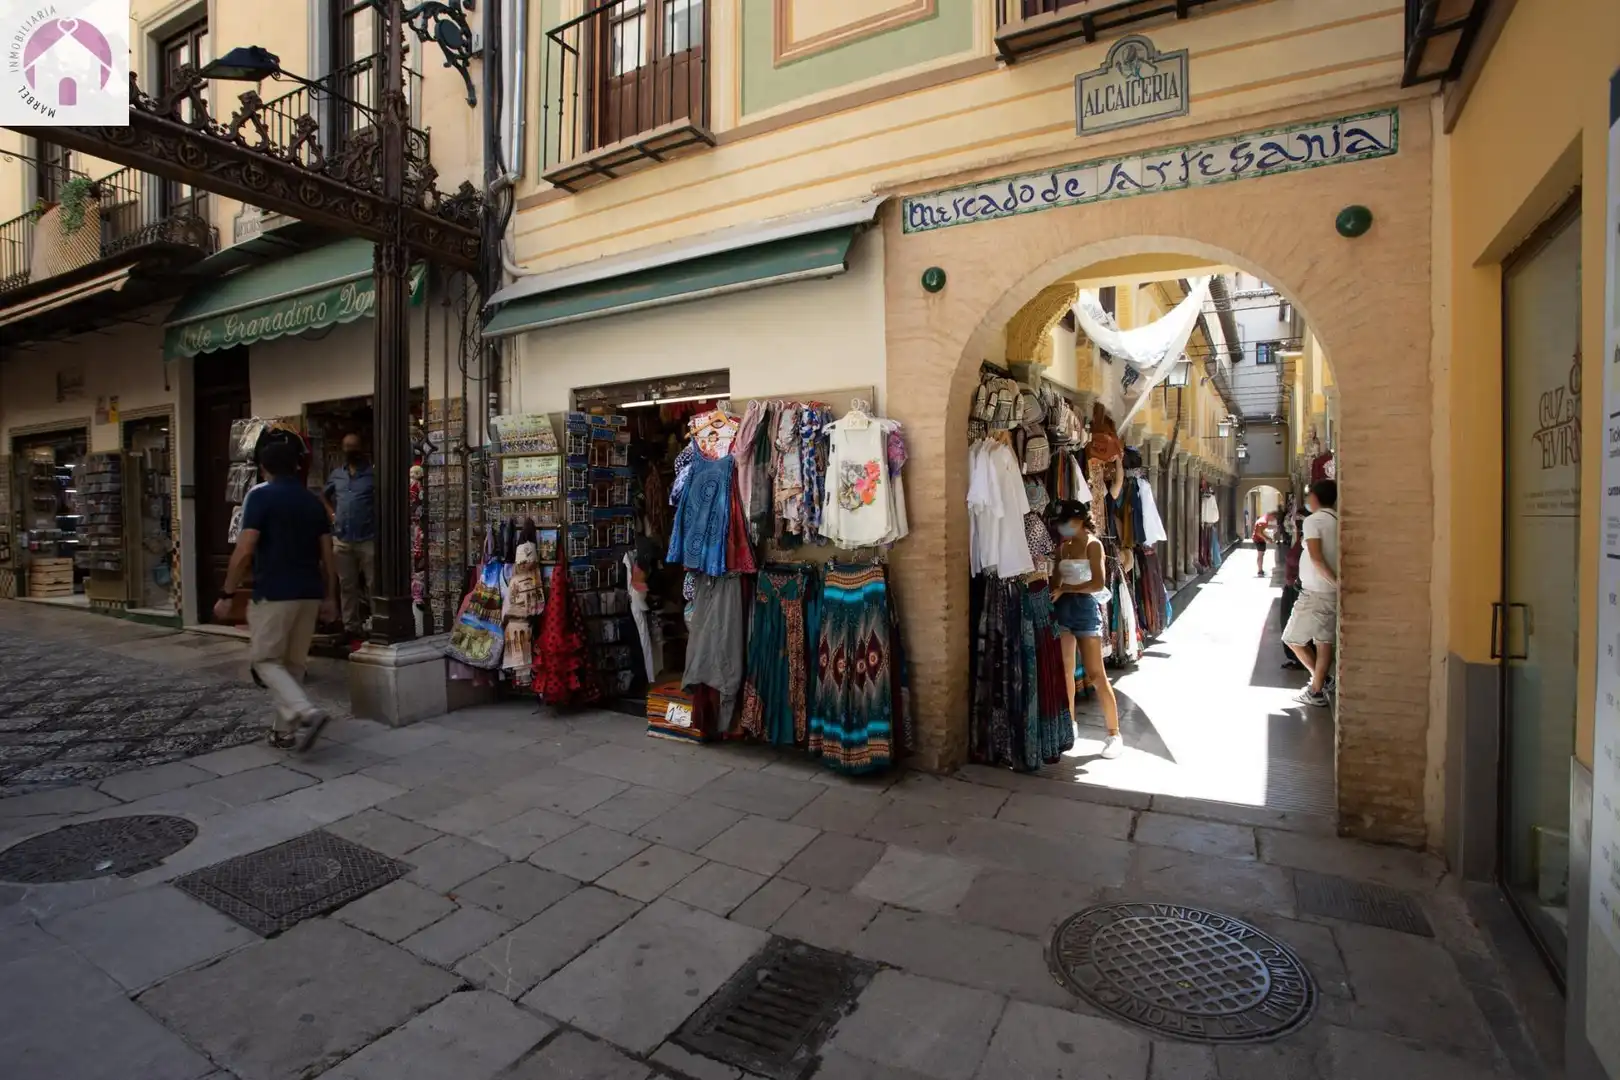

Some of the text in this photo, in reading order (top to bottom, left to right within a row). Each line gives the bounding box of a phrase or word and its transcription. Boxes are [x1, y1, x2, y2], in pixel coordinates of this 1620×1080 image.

[1084, 71, 1179, 118] ALCAICERIA
[223, 299, 328, 342] Granadino
[1150, 904, 1254, 940] NACIONAL
